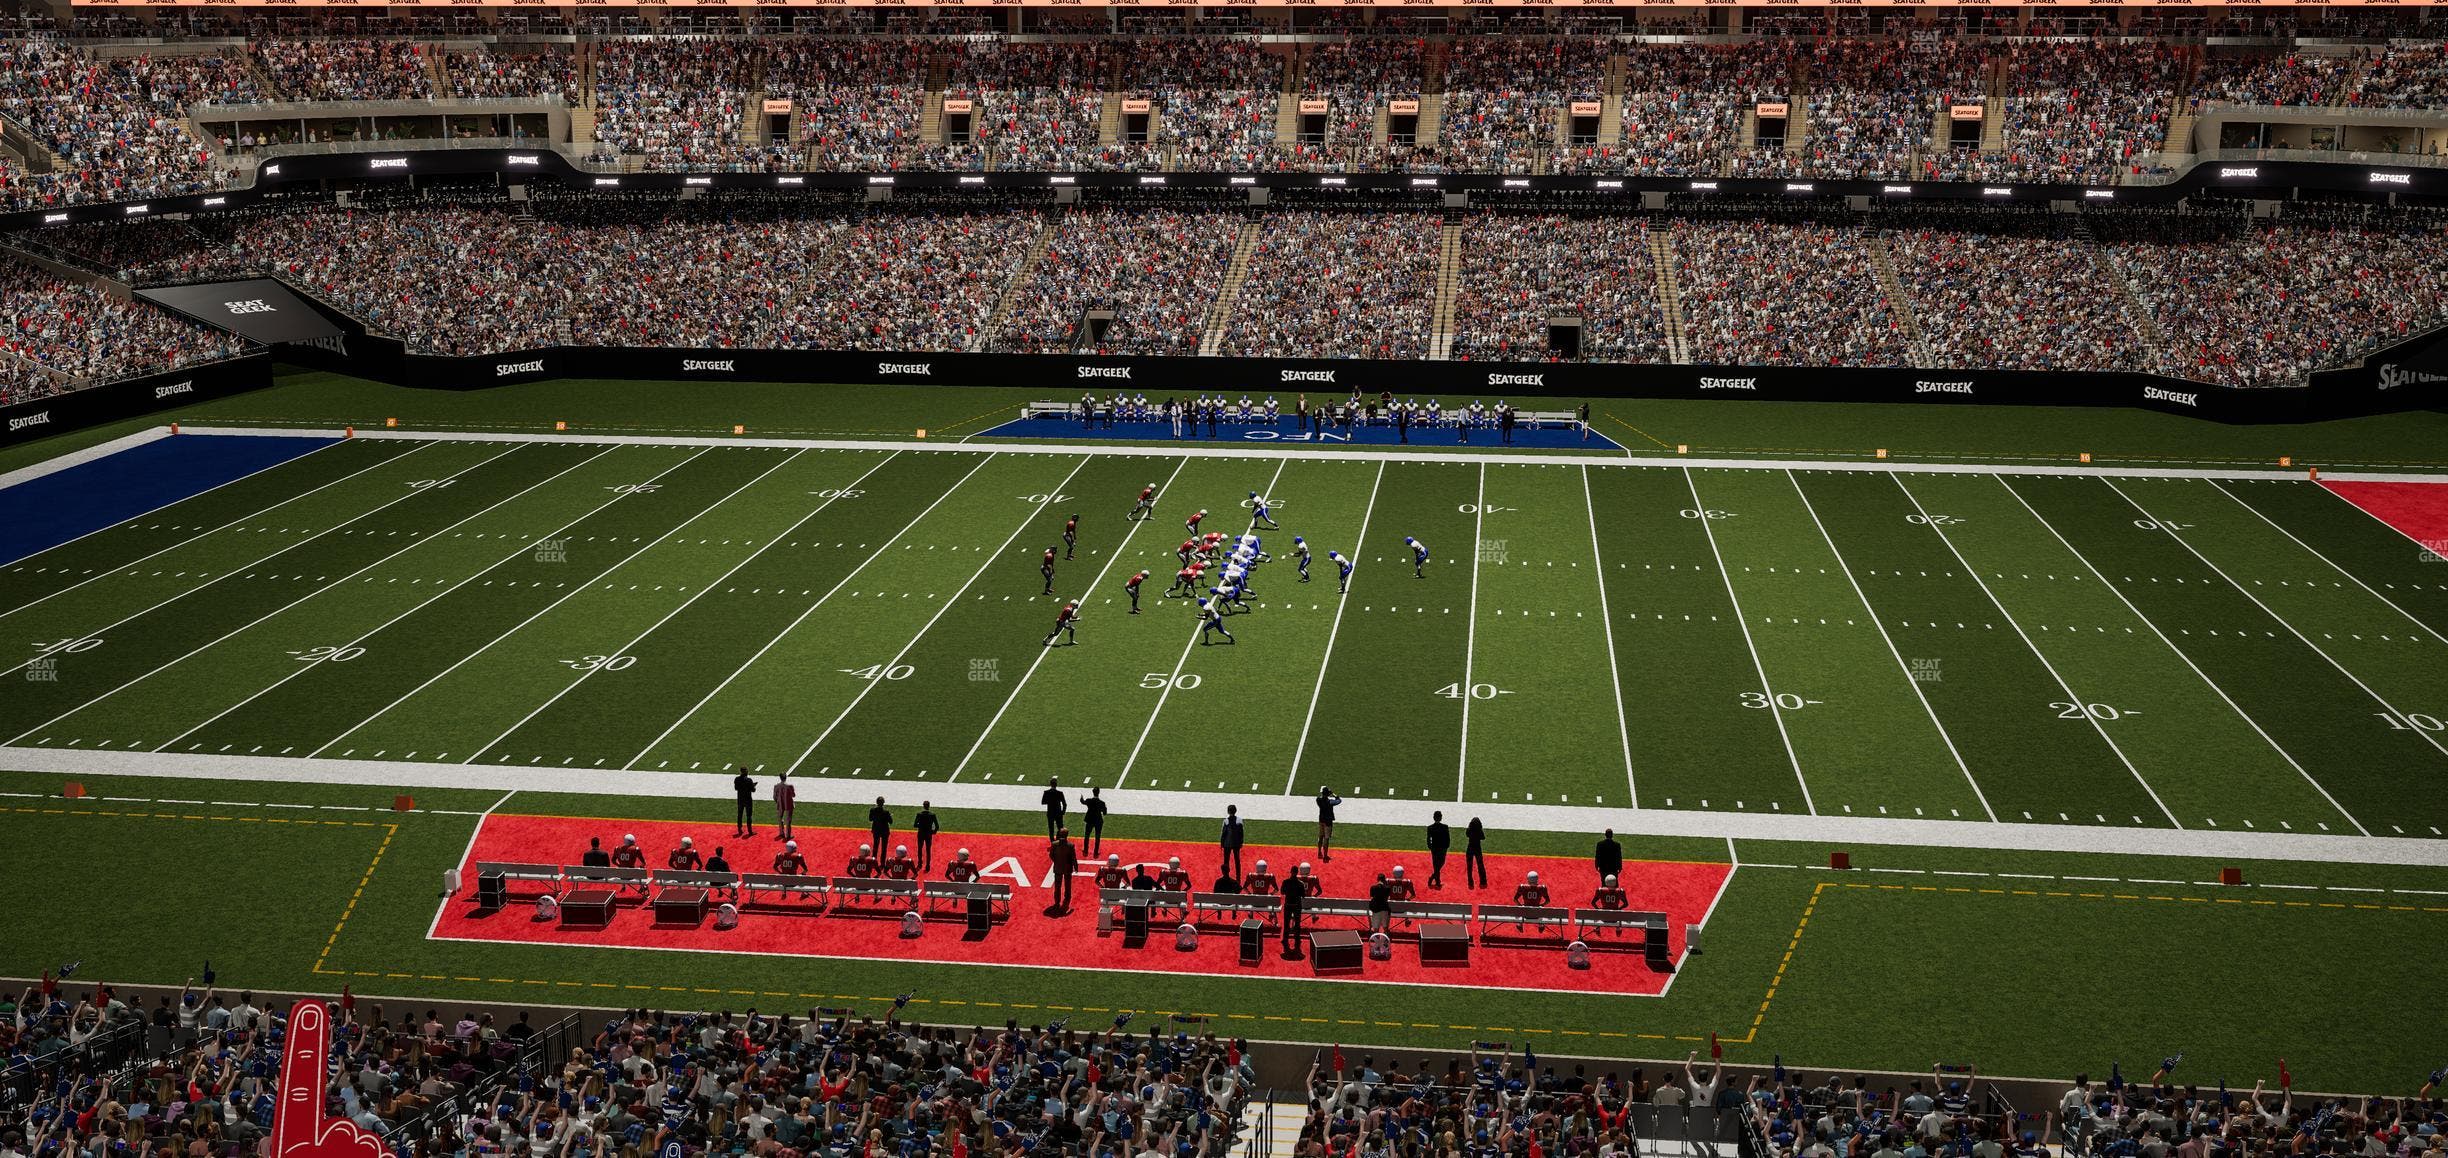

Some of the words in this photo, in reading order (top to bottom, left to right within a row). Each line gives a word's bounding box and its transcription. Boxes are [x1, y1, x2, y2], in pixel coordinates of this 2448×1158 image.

[371, 158, 407, 168] SEATGEEK
[508, 156, 538, 165] SEATGEEK
[2221, 168, 2257, 177] SEATGEEK
[2370, 173, 2410, 184] SEATGEEK
[224, 299, 264, 309] SEAT
[230, 305, 277, 314] GEEK
[497, 360, 543, 376] SEATGEEK
[684, 360, 734, 371] SEATGEEK
[879, 363, 931, 375] SEATGEEK
[1078, 367, 1131, 378] SEATGEEK
[1282, 370, 1335, 382] SEATGEEK
[1489, 374, 1543, 386] SEATGEEK
[1700, 378, 1756, 390] SEATGEEK
[156, 381, 193, 398] SEATGEEK
[1916, 381, 1973, 393] SEATGEEK
[2144, 387, 2197, 406] SEATGEEK
[9, 411, 49, 431] SEATGEEK
[35, 638, 104, 652] 10
[294, 646, 367, 662] 20
[571, 655, 637, 670] 30
[850, 664, 915, 680] 40
[1139, 673, 1202, 690] 50
[1433, 683, 1497, 700] 40
[1740, 692, 1804, 710] 30
[2049, 702, 2119, 720] 20
[2373, 713, 2445, 730] 10
[620, 853, 630, 861] 00
[677, 856, 687, 864] 00
[783, 860, 793, 868] 00
[857, 863, 867, 871] 00
[893, 865, 903, 873] 00
[955, 867, 965, 876] 00
[1106, 873, 1116, 882] 00
[1168, 876, 1178, 885] 00
[1255, 880, 1265, 888] 00
[1392, 886, 1402, 894] 00
[1527, 891, 1537, 900] 00
[1605, 895, 1615, 903] 00
